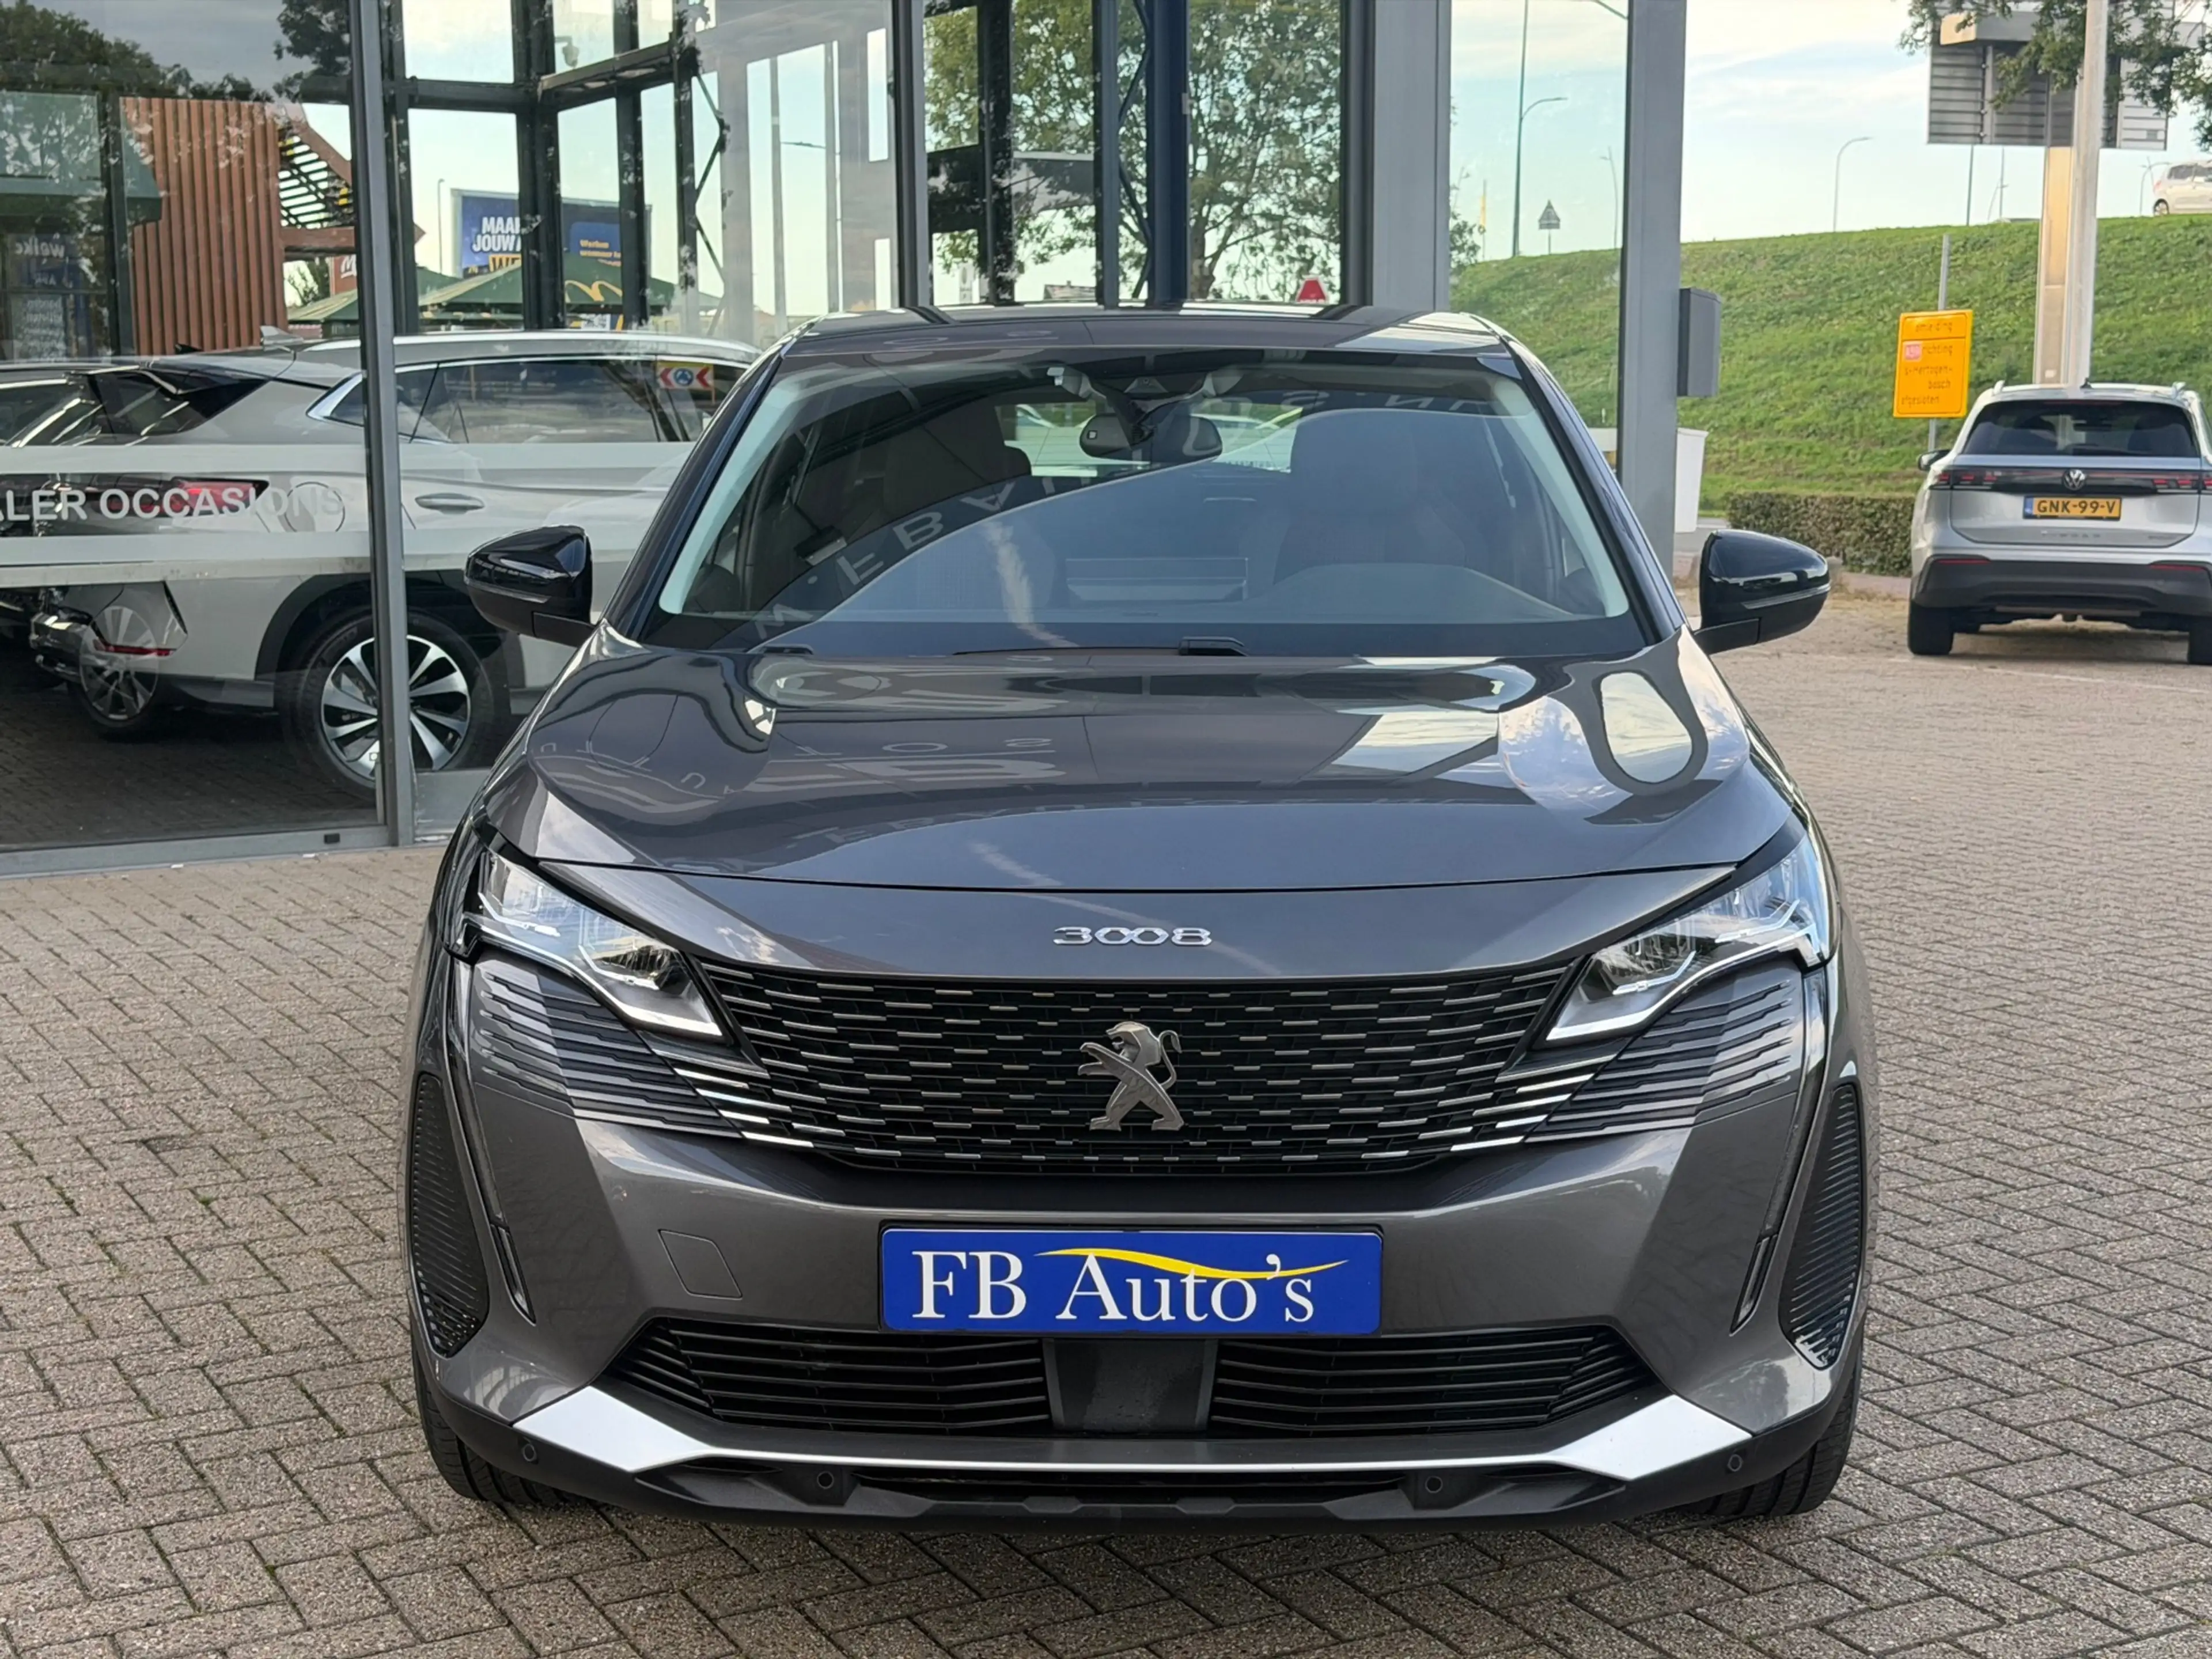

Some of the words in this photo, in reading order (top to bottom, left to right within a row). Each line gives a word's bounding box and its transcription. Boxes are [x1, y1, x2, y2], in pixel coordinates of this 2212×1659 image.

[472, 234, 515, 252] JOUW
[0, 490, 87, 521] LER
[99, 488, 344, 518] OCCASIONS
[2037, 500, 2116, 514] GNK-99-V
[1053, 926, 1212, 946] 3008
[912, 1251, 1027, 1320] FB
[1055, 1253, 1315, 1323] Auto's
